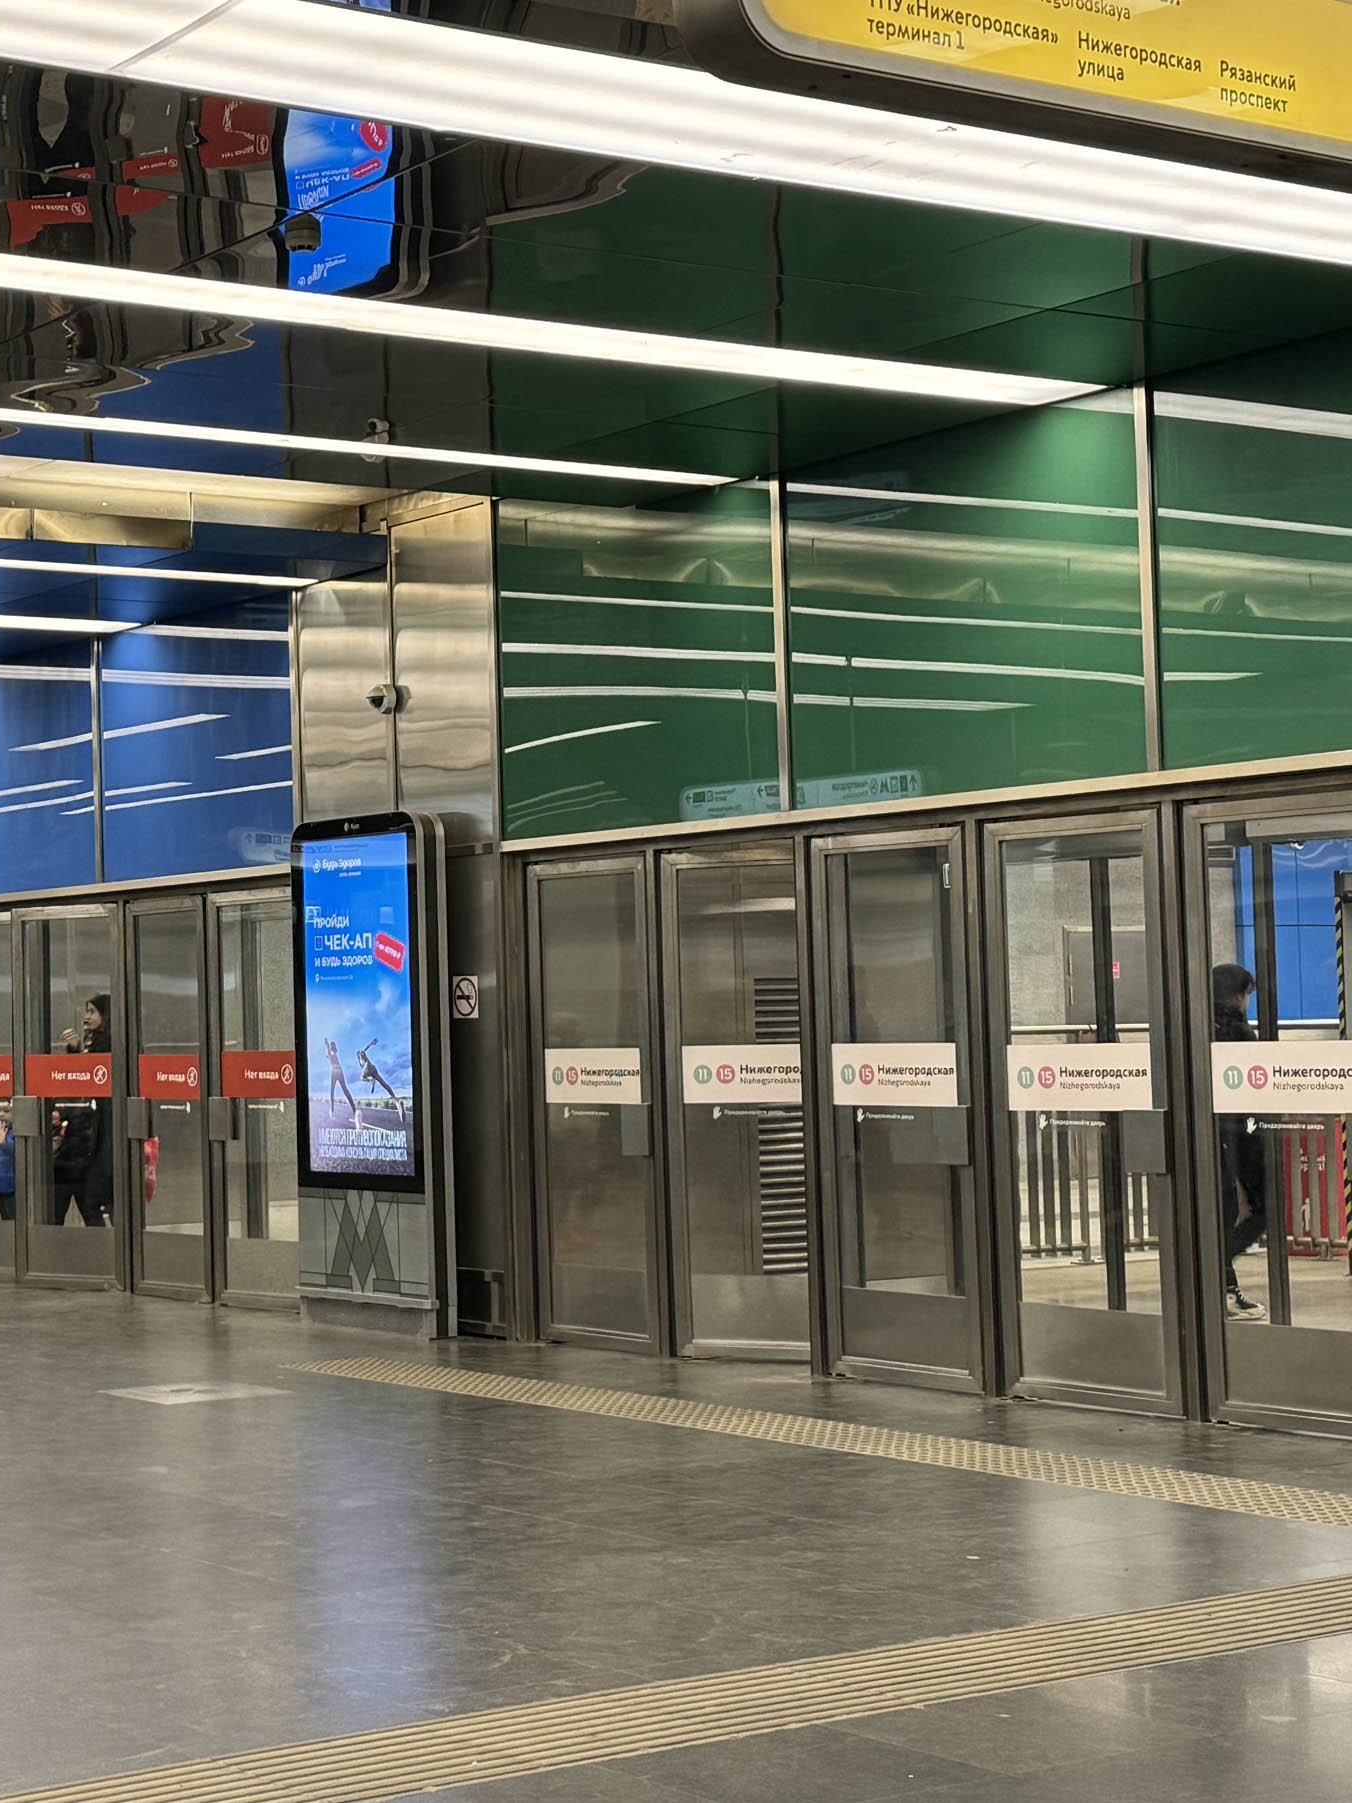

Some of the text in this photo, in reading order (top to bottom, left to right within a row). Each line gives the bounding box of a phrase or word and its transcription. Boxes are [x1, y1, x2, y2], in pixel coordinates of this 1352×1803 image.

[906, 0, 1058, 44] «Нижегородская»
[867, 18, 965, 50] терминал 1
[1078, 30, 1202, 72] Нижегородская
[1078, 58, 1125, 83] улица
[1220, 60, 1297, 92] Рязанский
[1220, 86, 1288, 113] проспект
[314, 913, 349, 929] ПРОЙДИ
[325, 933, 372, 951] ЧЕК-АП
[315, 955, 373, 967] И БУДЬ ЗДОРОВ
[52, 1071, 66, 1080] Нет
[245, 1070, 257, 1079] Нет
[580, 1067, 640, 1078] Нижегородская
[720, 1068, 732, 1080] 15
[861, 1068, 872, 1080] 15
[878, 1064, 954, 1077] Нижегородская
[1040, 1071, 1053, 1084] 15
[1059, 1066, 1147, 1079] Нижегородская
[1228, 1070, 1238, 1084] 11
[1251, 1070, 1265, 1084] 15
[1059, 1082, 1120, 1091] Nizhegorodskaya
[1273, 1082, 1344, 1092] Nizhegorodskaya
